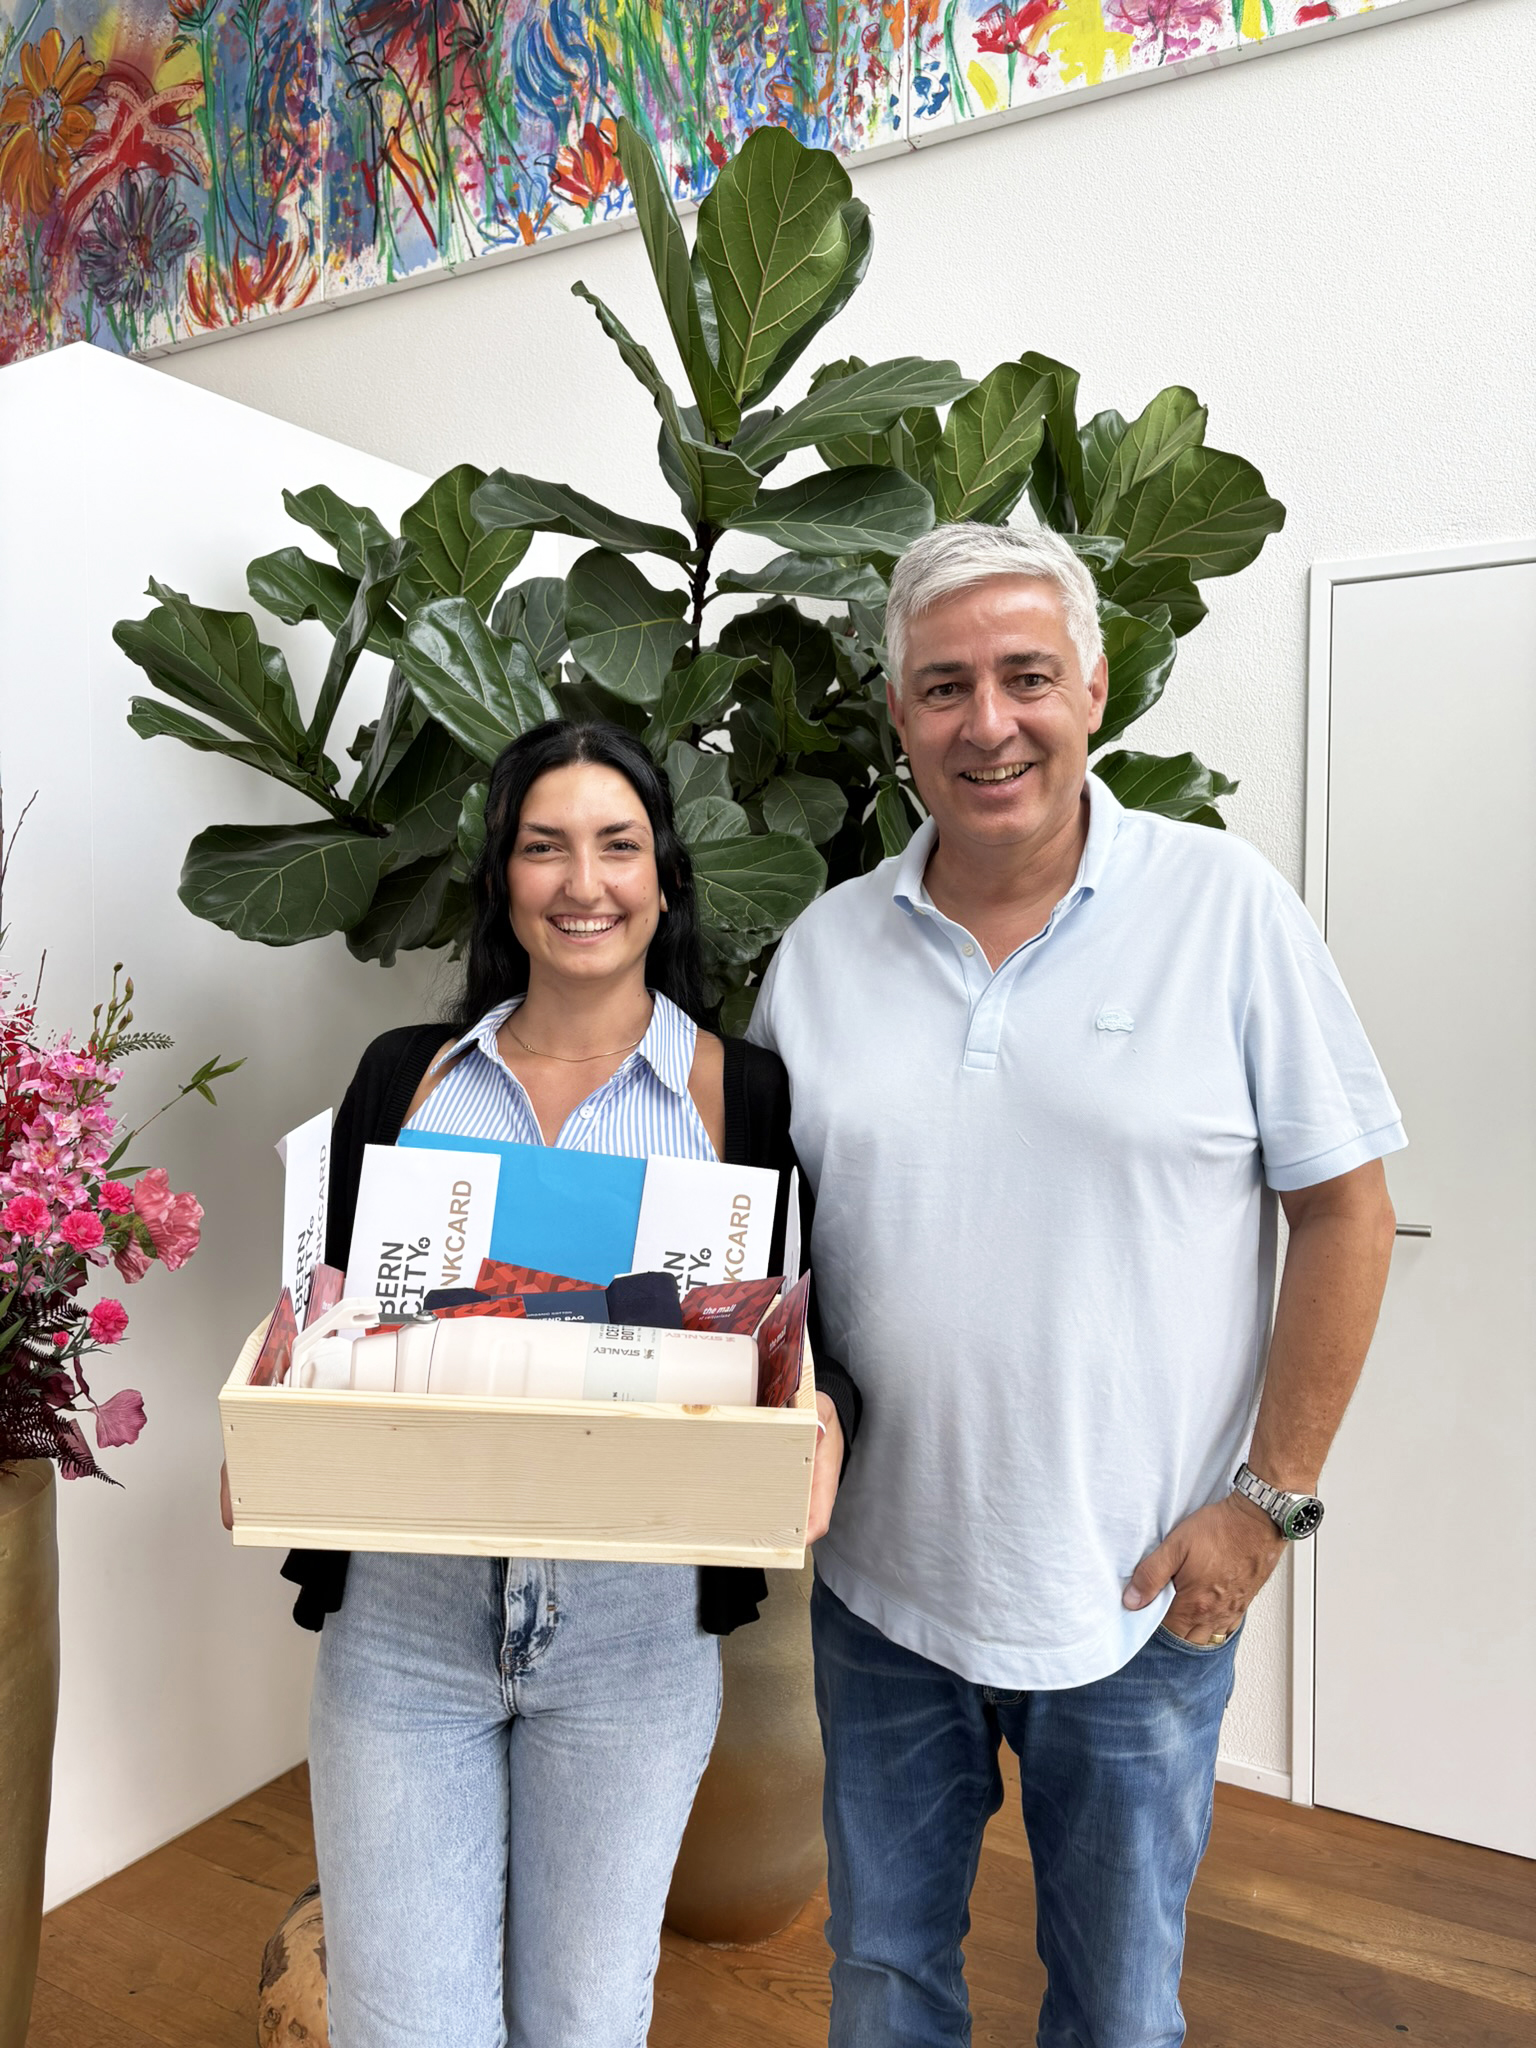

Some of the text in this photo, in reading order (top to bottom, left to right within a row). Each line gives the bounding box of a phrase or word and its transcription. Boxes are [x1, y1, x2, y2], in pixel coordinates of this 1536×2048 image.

[315, 1144, 328, 1261] NKCARD
[440, 1180, 472, 1287] NKCARD
[722, 1194, 752, 1283] KCARD
[295, 1230, 307, 1315] BERN
[303, 1228, 314, 1306] CITY
[400, 1243, 429, 1314] CITY
[593, 1346, 641, 1357] STANLEY
[664, 1331, 723, 1341] STANLEY
